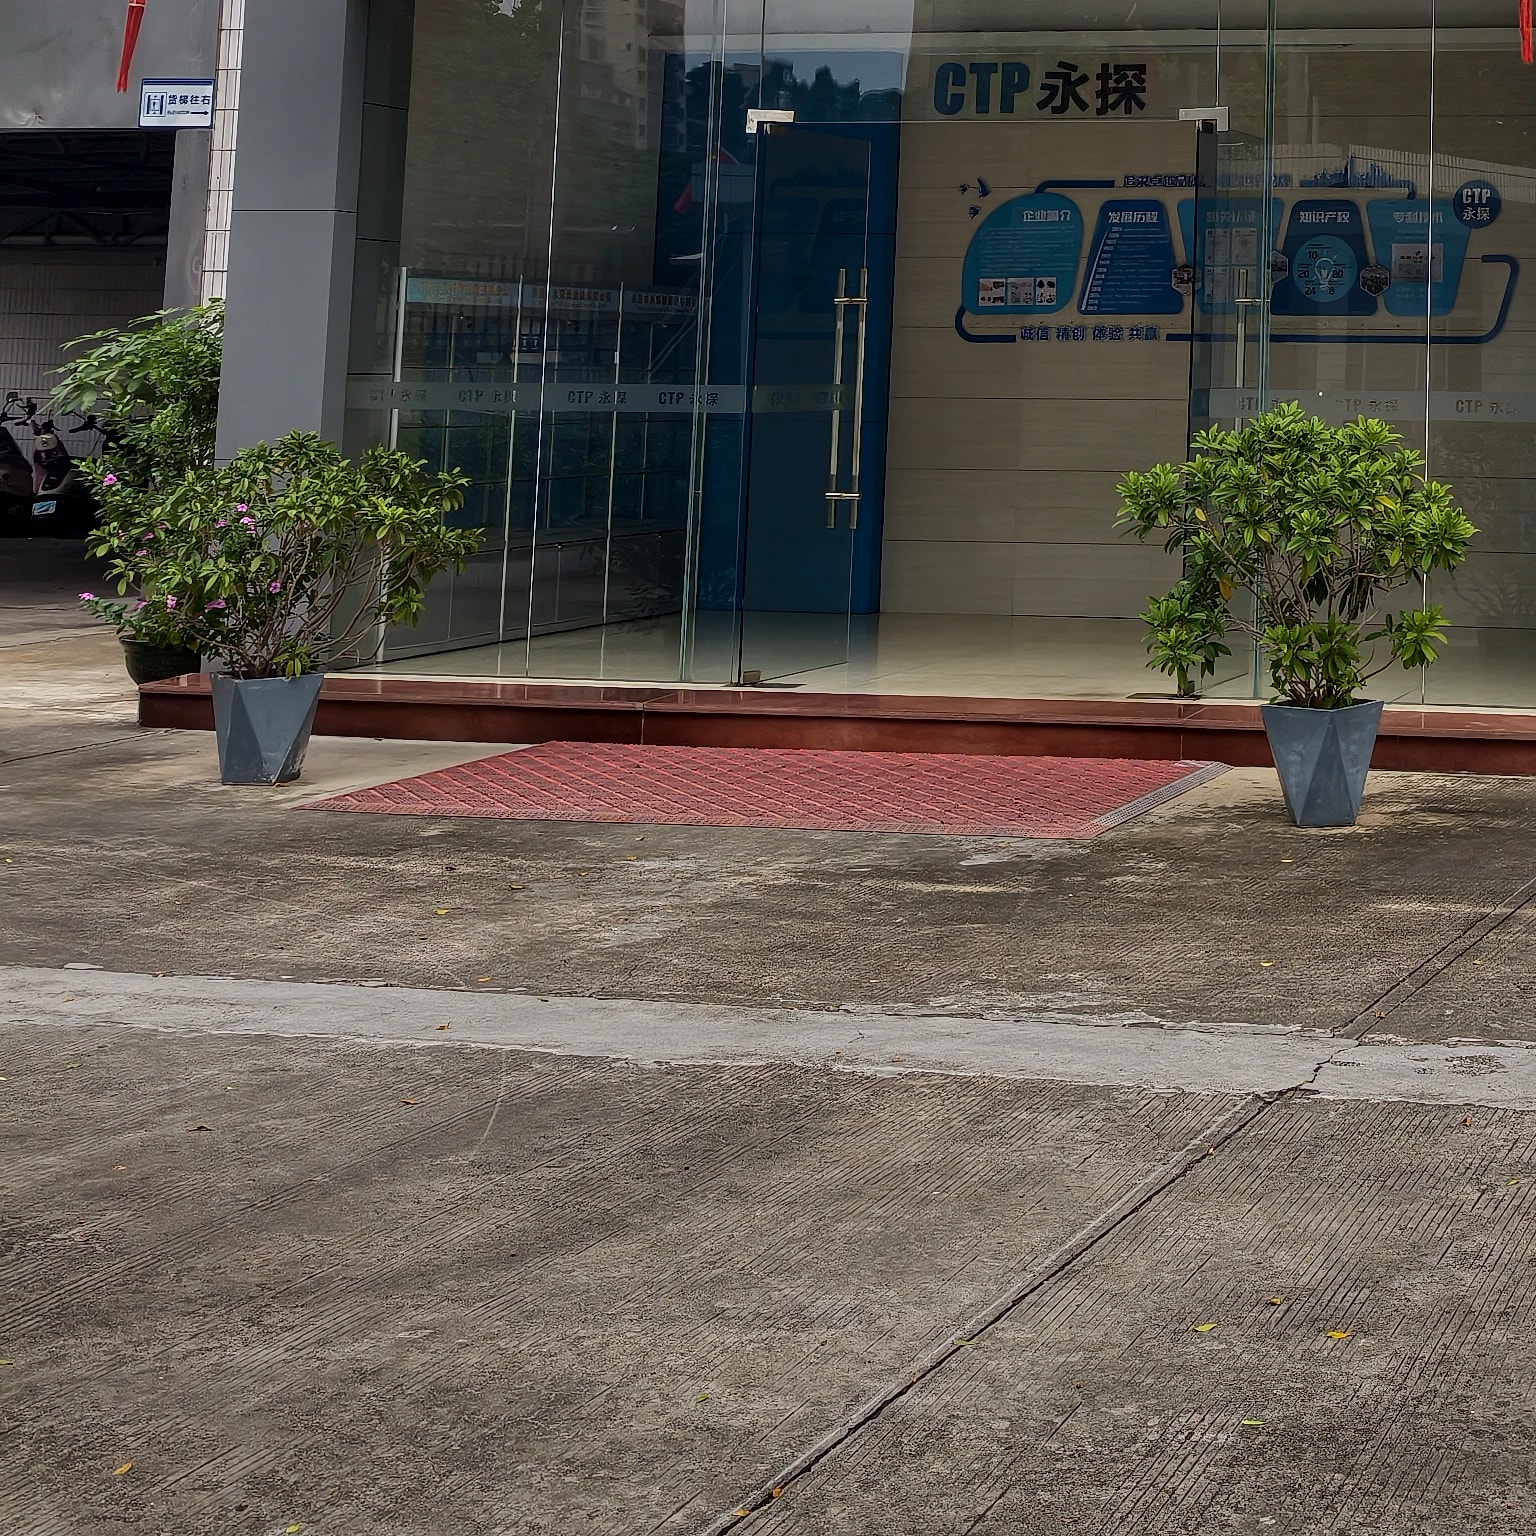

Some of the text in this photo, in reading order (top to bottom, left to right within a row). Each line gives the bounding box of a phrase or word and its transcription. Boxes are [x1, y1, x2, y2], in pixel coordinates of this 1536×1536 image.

[934, 60, 1148, 115] CTP 永探
[1462, 188, 1491, 204] CTP
[1108, 210, 1159, 224] 发展历程
[1299, 210, 1350, 224] 知识产权
[1462, 207, 1491, 221] 永探
[568, 391, 593, 404] CTP
[658, 392, 684, 405] CTP
[1455, 399, 1483, 414] CTP
